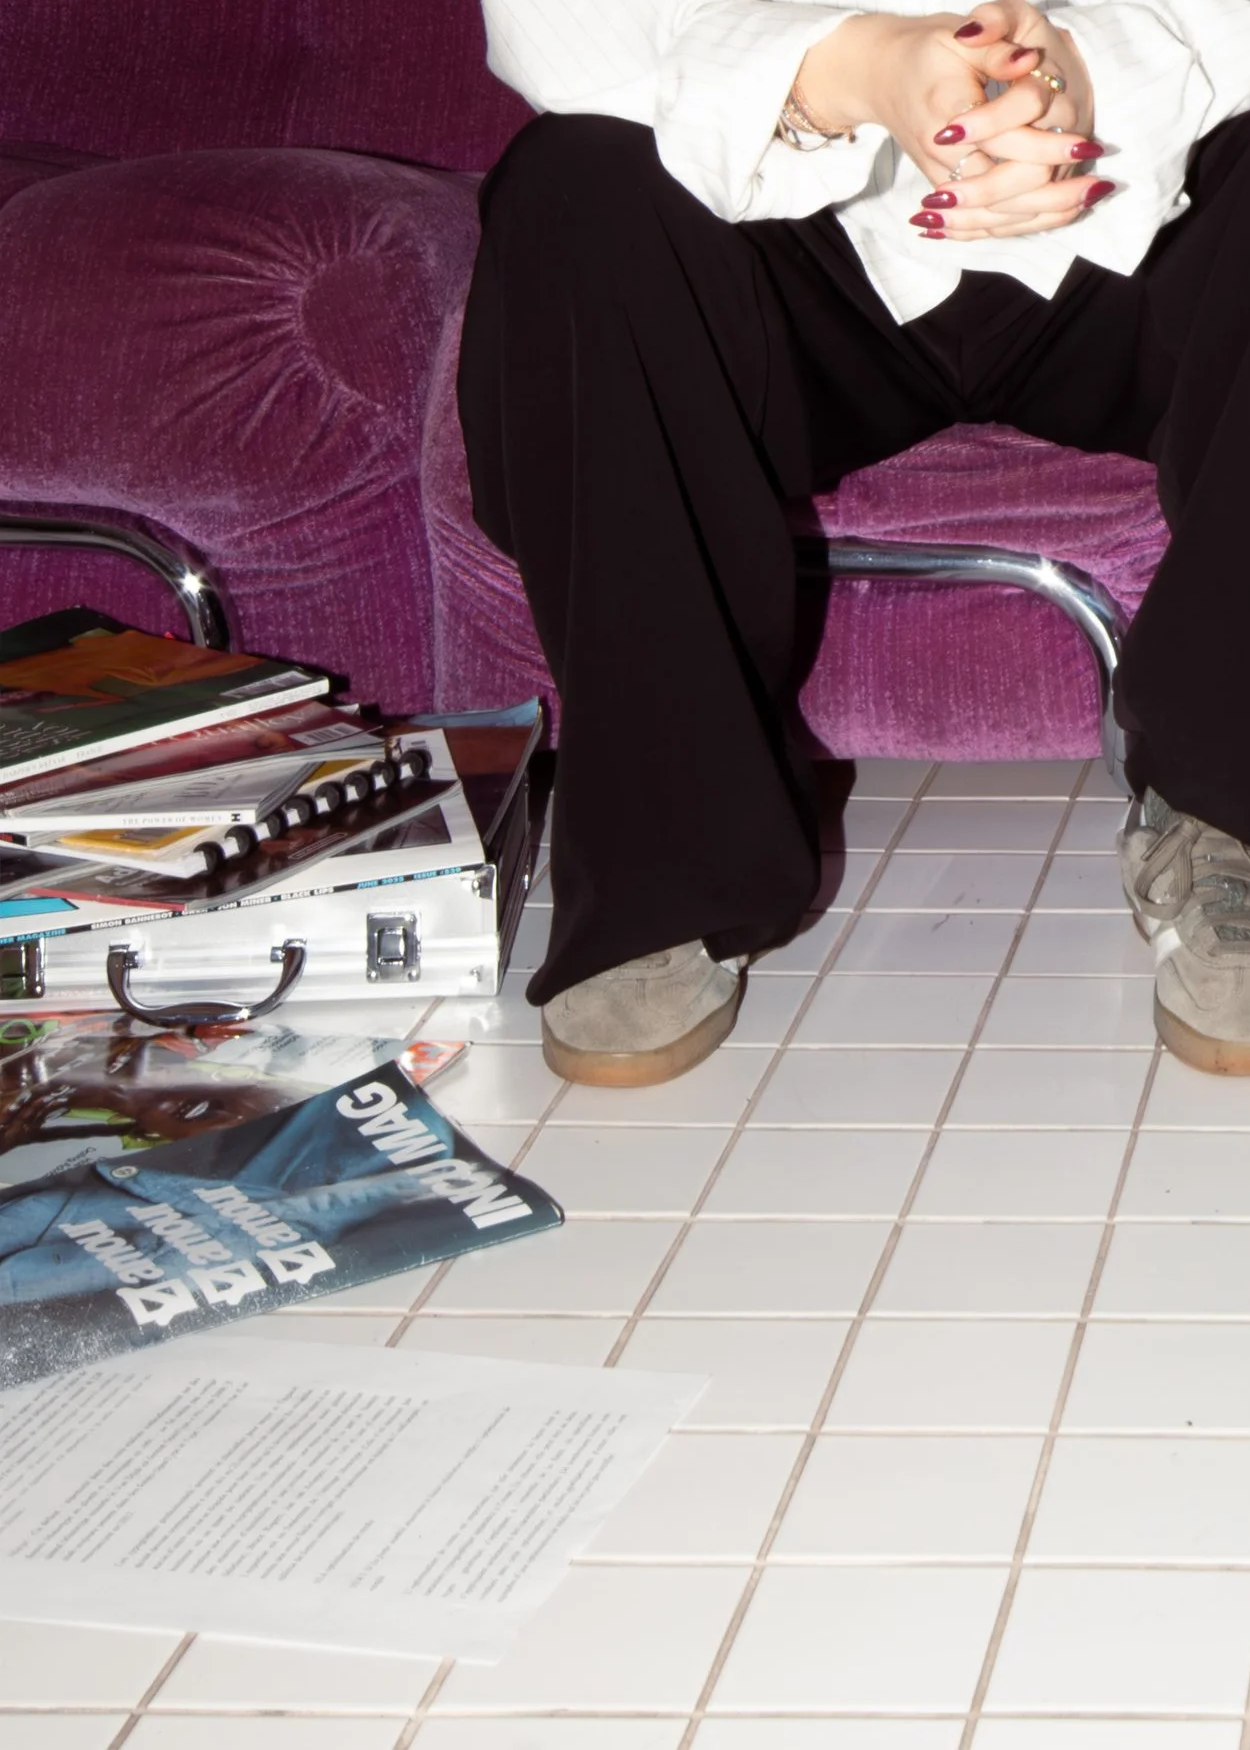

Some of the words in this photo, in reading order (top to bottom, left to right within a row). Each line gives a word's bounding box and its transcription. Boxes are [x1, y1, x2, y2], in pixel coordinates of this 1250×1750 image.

[16, 928, 66, 942] MAGAZINE
[91, 919, 122, 930] SIMON
[280, 889, 311, 900] BLACK
[314, 886, 334, 897] LIPS
[357, 879, 378, 889] JUNE
[413, 870, 437, 880] ISSUE
[336, 1081, 448, 1165] MAG
[192, 1185, 301, 1247] amour
[402, 1158, 533, 1229] INCU
[58, 1219, 165, 1284] amour
[125, 1202, 233, 1265] amour
